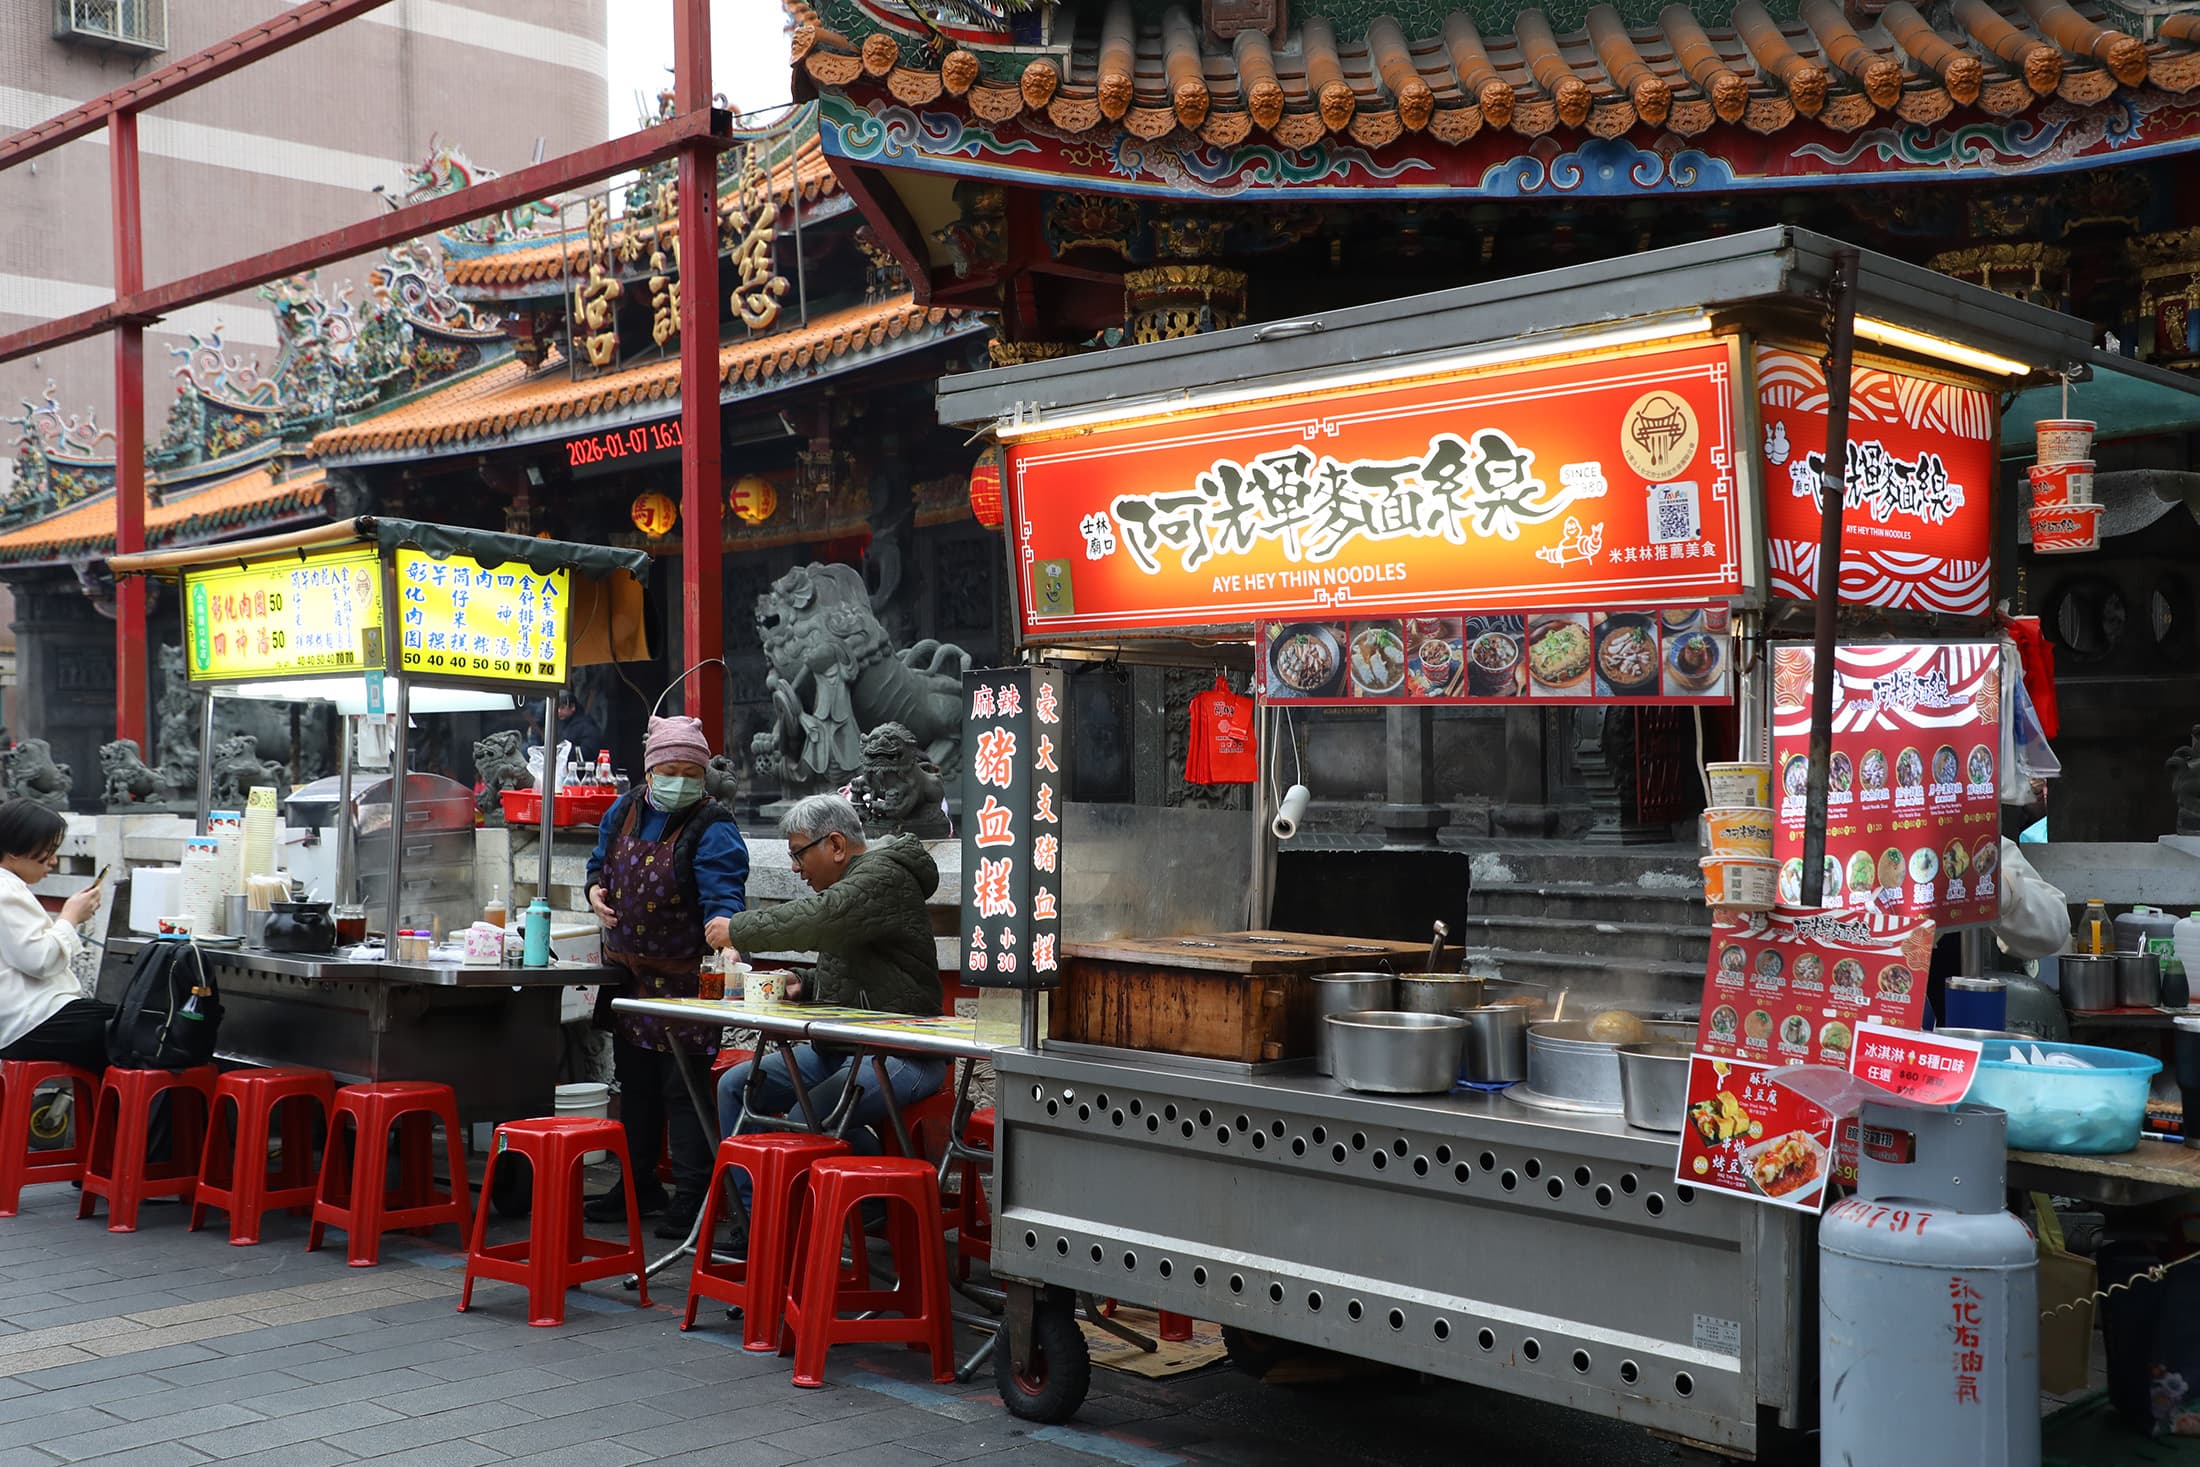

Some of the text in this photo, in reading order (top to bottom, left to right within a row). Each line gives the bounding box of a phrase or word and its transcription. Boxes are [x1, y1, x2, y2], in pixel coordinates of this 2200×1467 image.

[566, 427, 648, 466] 2026-01-07
[1564, 466, 1597, 480] SINCE
[1083, 517, 1109, 534] 士林
[1846, 524, 1912, 541] AYE HEY THIN NOODLES
[1090, 537, 1113, 555] 廟口
[1609, 541, 1717, 564] 米其林推薦美食
[1212, 562, 1407, 593] AYE HEY THIN NOODLES
[269, 593, 282, 612] 50
[404, 561, 428, 650] 彰化肉圓
[451, 567, 470, 653] 筒仔米糕
[495, 575, 515, 658] 四神湯
[517, 574, 536, 660] 金針排骨湯
[272, 630, 285, 649] 50
[336, 652, 346, 665] 70
[346, 651, 355, 664] 70
[404, 652, 555, 676] 50 40 40 50 50 70 70
[970, 684, 1023, 721] 麻辣
[974, 726, 1017, 920] 豬血糕
[1031, 682, 1060, 974] 豪大支豬血糕
[970, 925, 1016, 950] 大 小
[969, 951, 1016, 974] 50 30
[1864, 1042, 1904, 1064] 冰淇淋
[1867, 1065, 1893, 1082] 任選
[1742, 1085, 1778, 1106] 臭豆腐
[1721, 1136, 1748, 1158] 串燒
[1712, 1154, 1754, 1179] 烤豆腐
